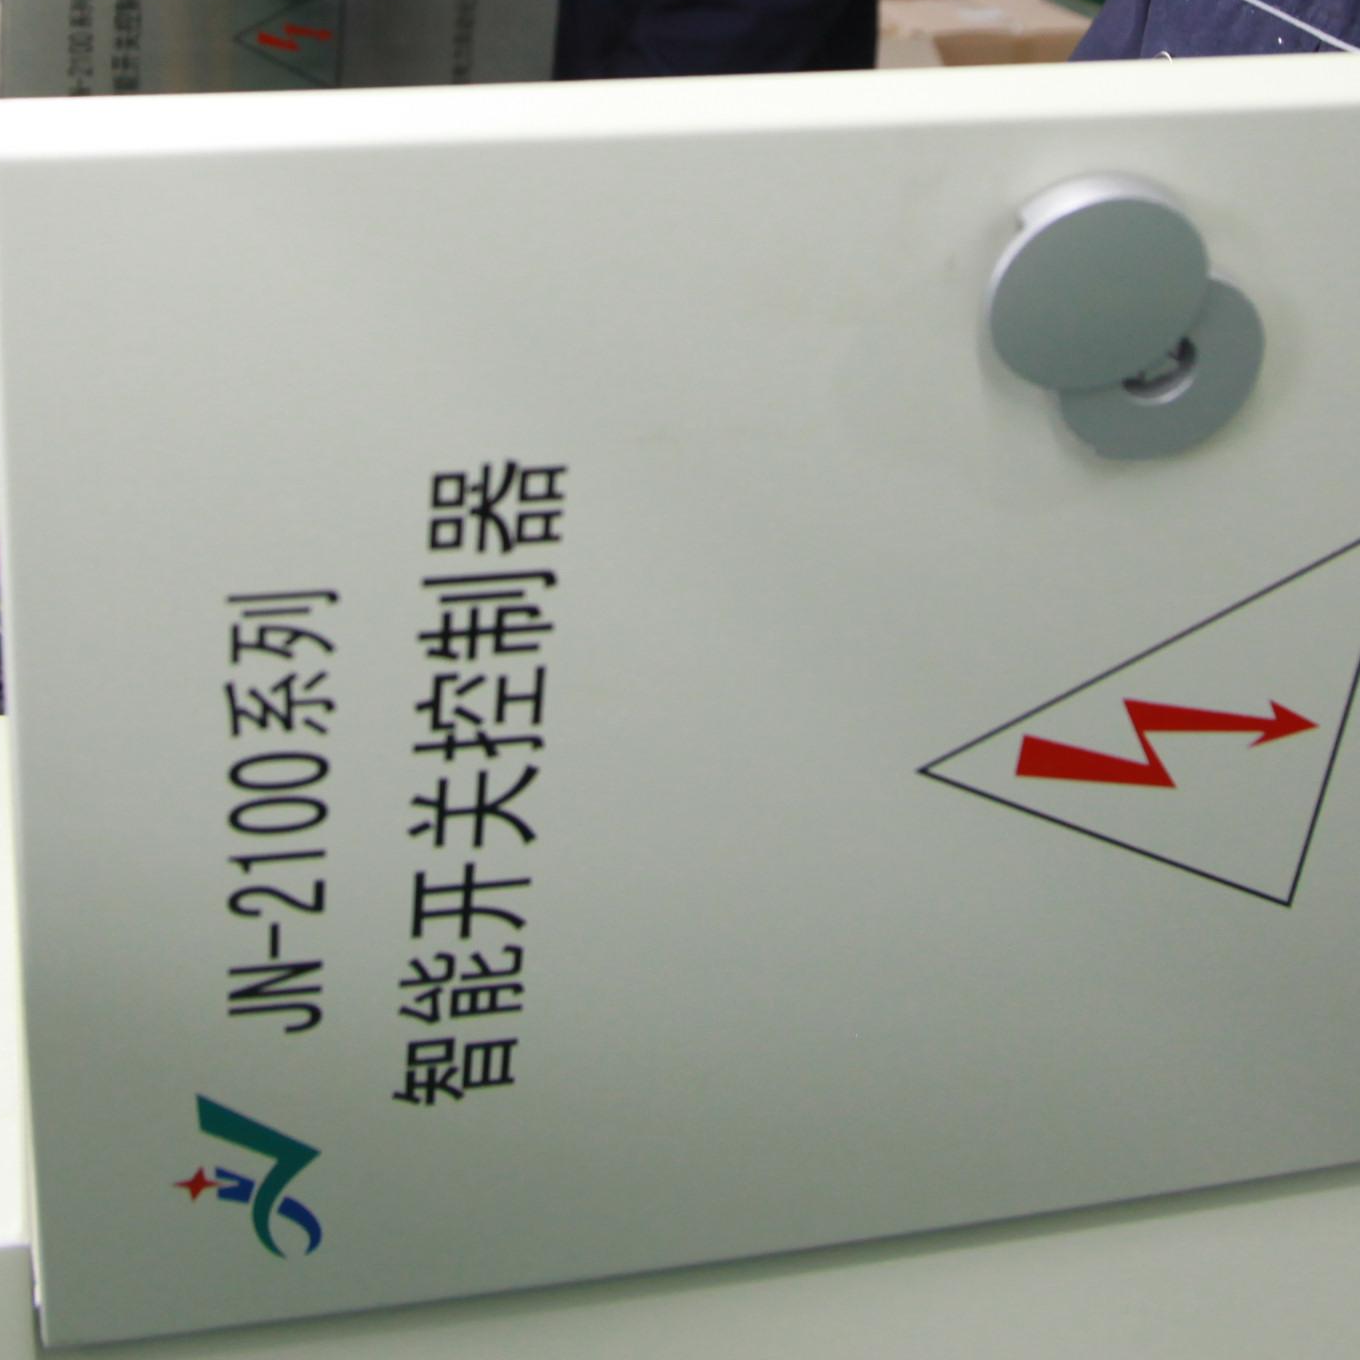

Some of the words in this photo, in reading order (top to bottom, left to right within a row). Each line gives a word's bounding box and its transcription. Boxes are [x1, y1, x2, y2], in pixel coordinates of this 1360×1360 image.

[224, 588, 340, 1034] JN-2100系列
[392, 458, 570, 1108] 智能开关控制器
